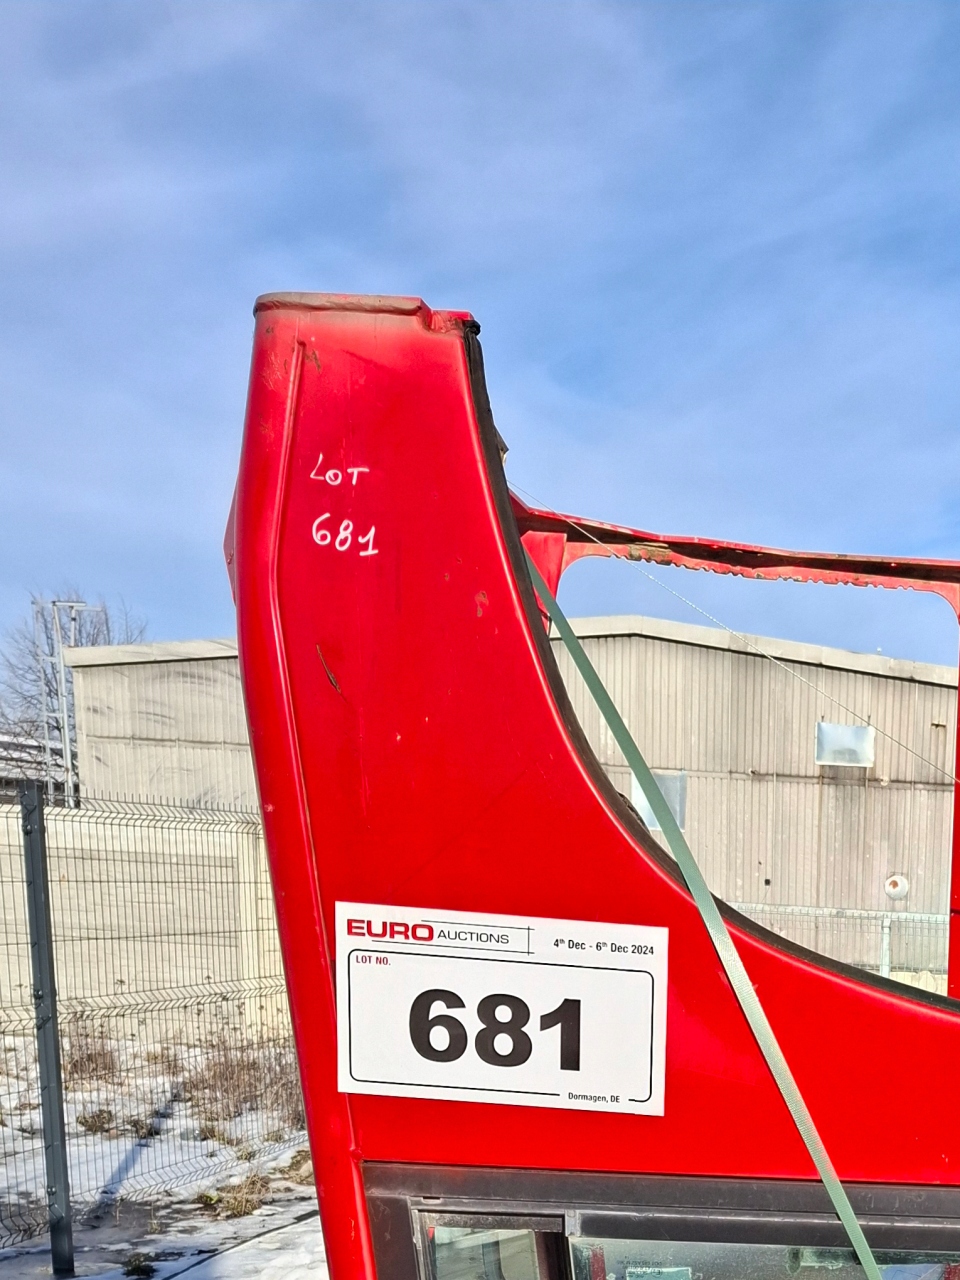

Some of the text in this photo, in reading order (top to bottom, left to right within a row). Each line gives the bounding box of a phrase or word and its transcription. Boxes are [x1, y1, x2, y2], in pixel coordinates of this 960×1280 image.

[310, 452, 370, 485] LOT
[312, 512, 379, 556] 681
[347, 918, 510, 945] EURO AUCTIONS
[553, 938, 565, 948] 4th
[568, 939, 586, 950] Dec
[596, 941, 608, 952] 6th
[610, 942, 629, 953] Dec
[631, 944, 654, 955] 2024
[356, 955, 391, 966] LOT NO.
[409, 988, 581, 1072] 681
[568, 1091, 620, 1104] Dormagen, DE
